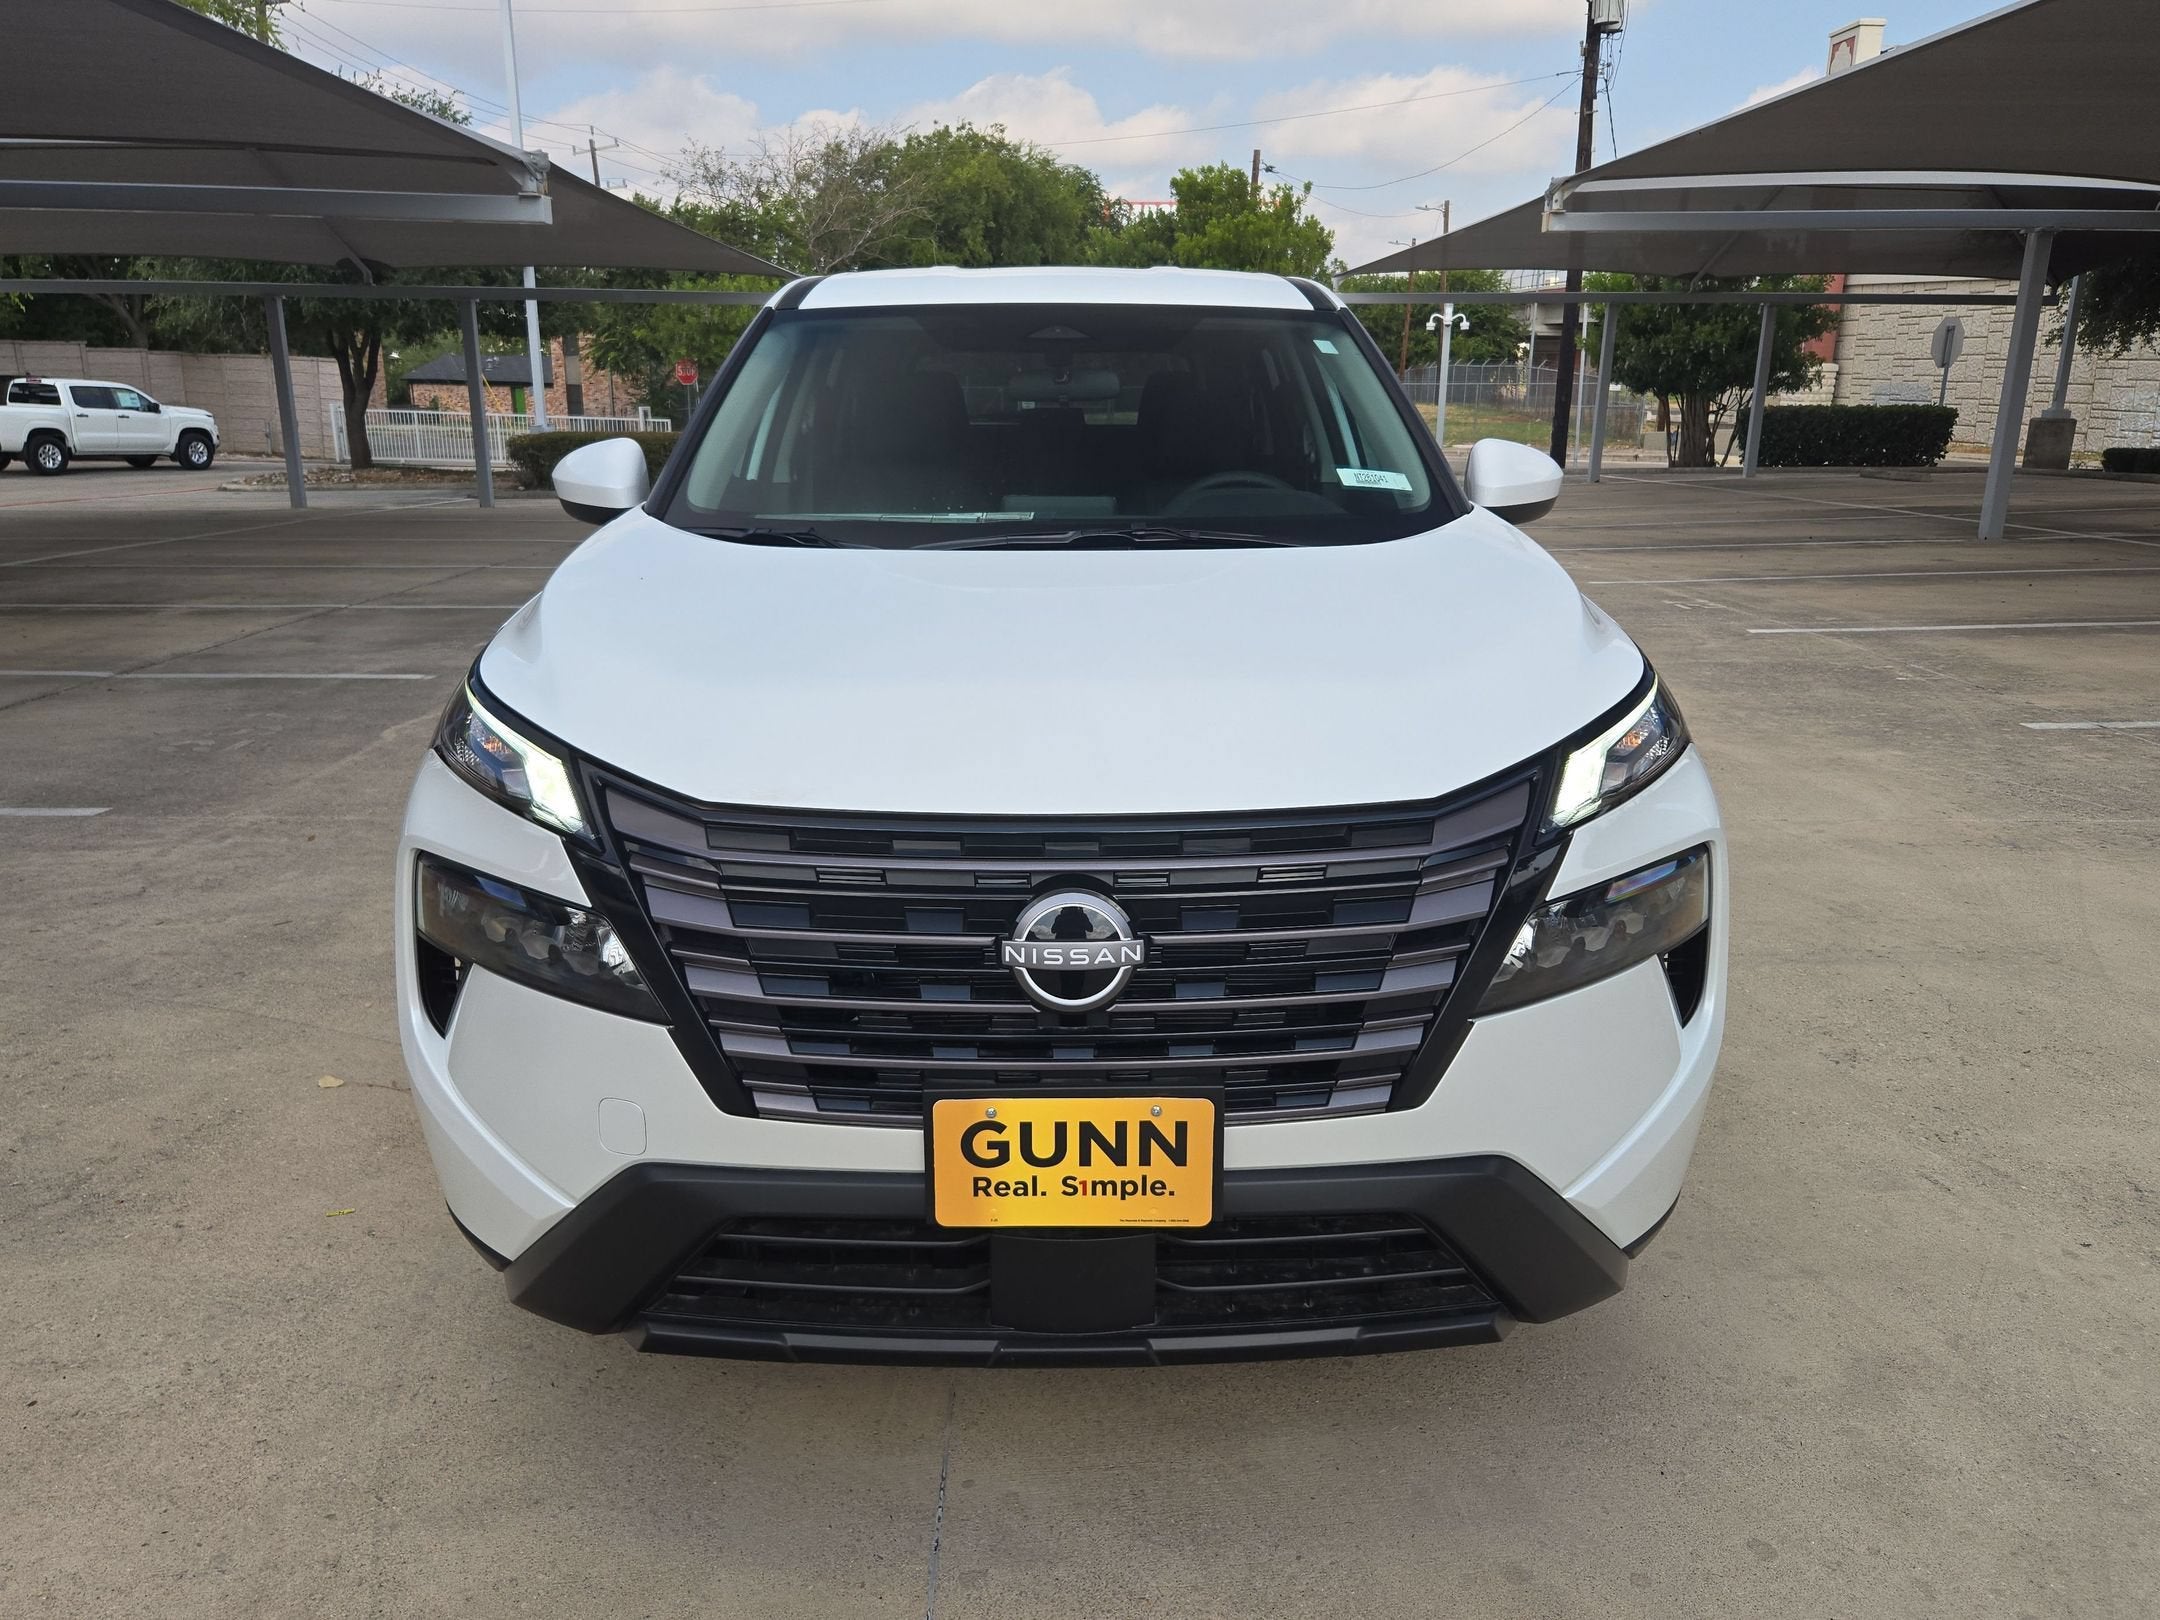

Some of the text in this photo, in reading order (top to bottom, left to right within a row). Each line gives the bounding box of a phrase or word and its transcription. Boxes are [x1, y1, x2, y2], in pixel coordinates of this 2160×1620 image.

[677, 366, 697, 376] STOP
[1005, 944, 1141, 965] NISSAN
[960, 1119, 1188, 1168] GUNN
[972, 1174, 1175, 1200] Real. S1mple.
